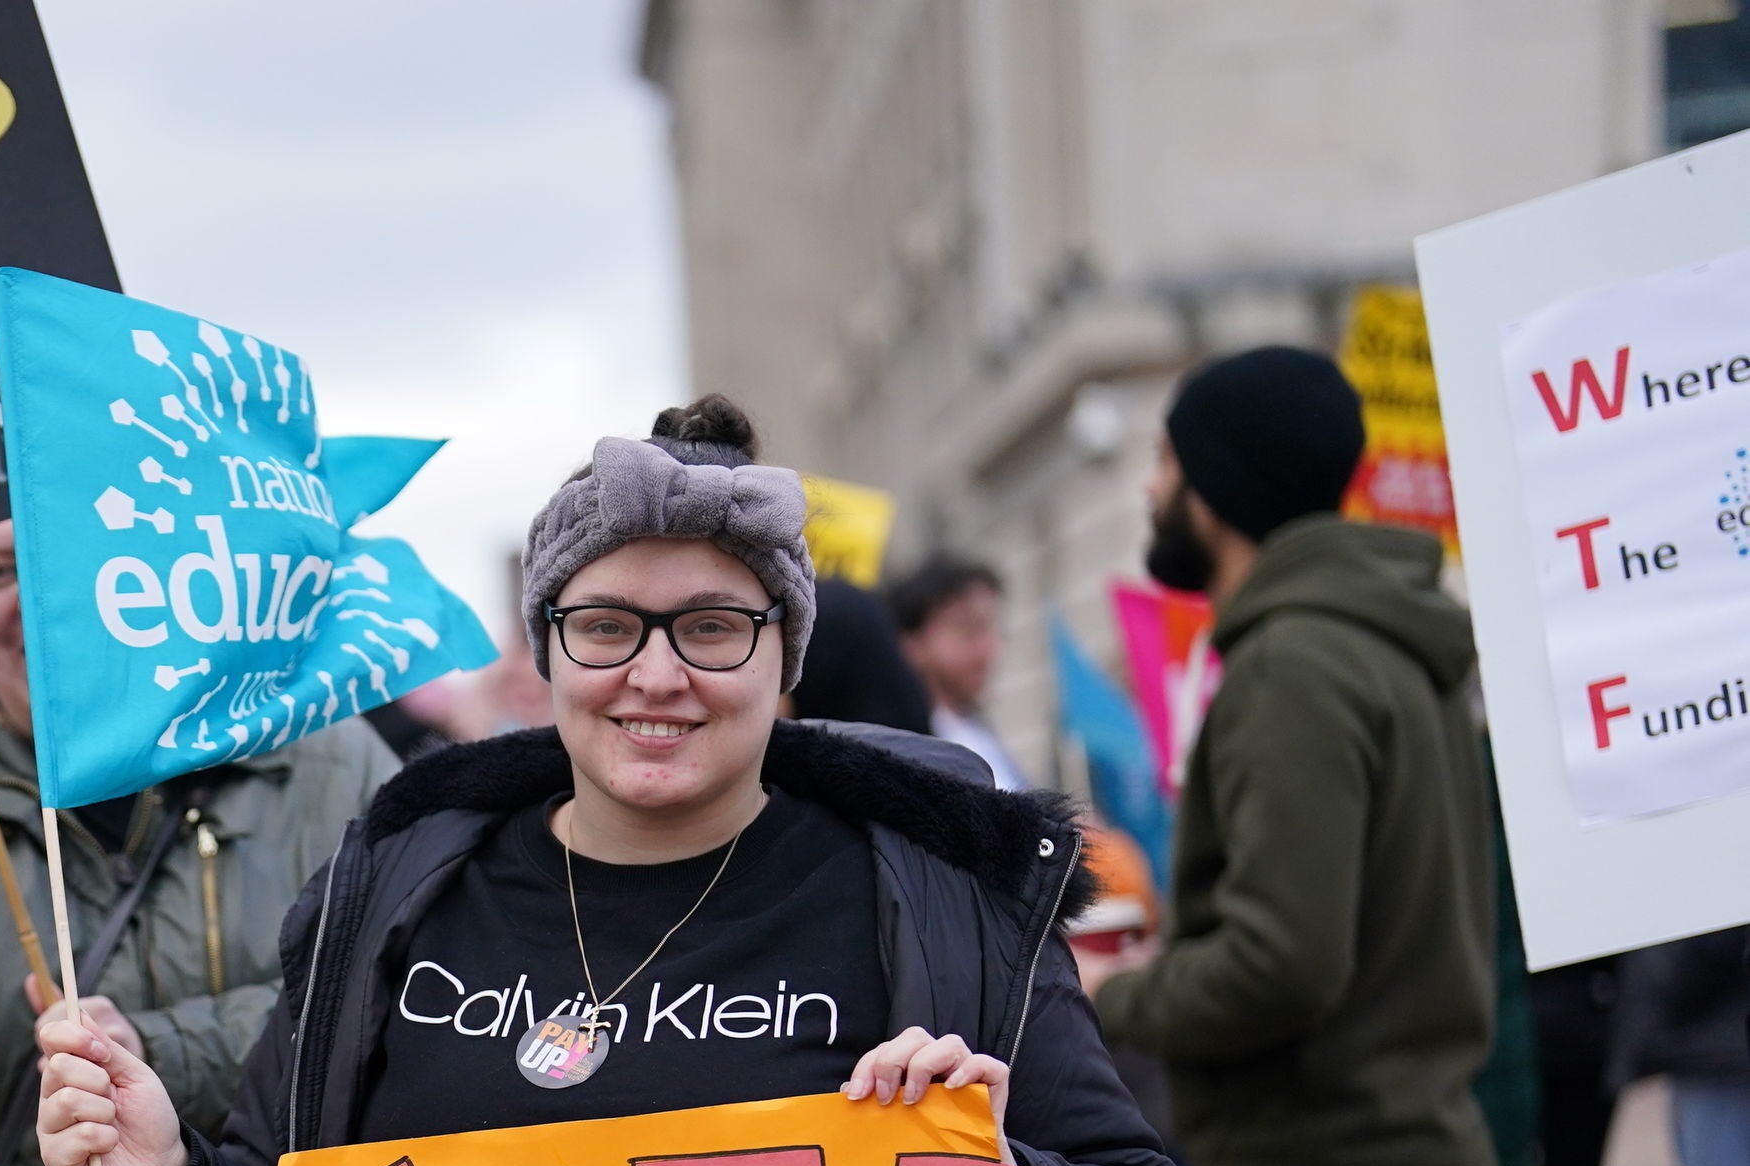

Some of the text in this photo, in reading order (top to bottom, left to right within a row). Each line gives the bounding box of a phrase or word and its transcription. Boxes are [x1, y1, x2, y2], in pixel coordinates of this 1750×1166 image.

[1532, 346, 1750, 433] Where
[1556, 517, 1679, 590] The
[1587, 675, 1750, 750] Fundi
[644, 979, 839, 1044] Klein
